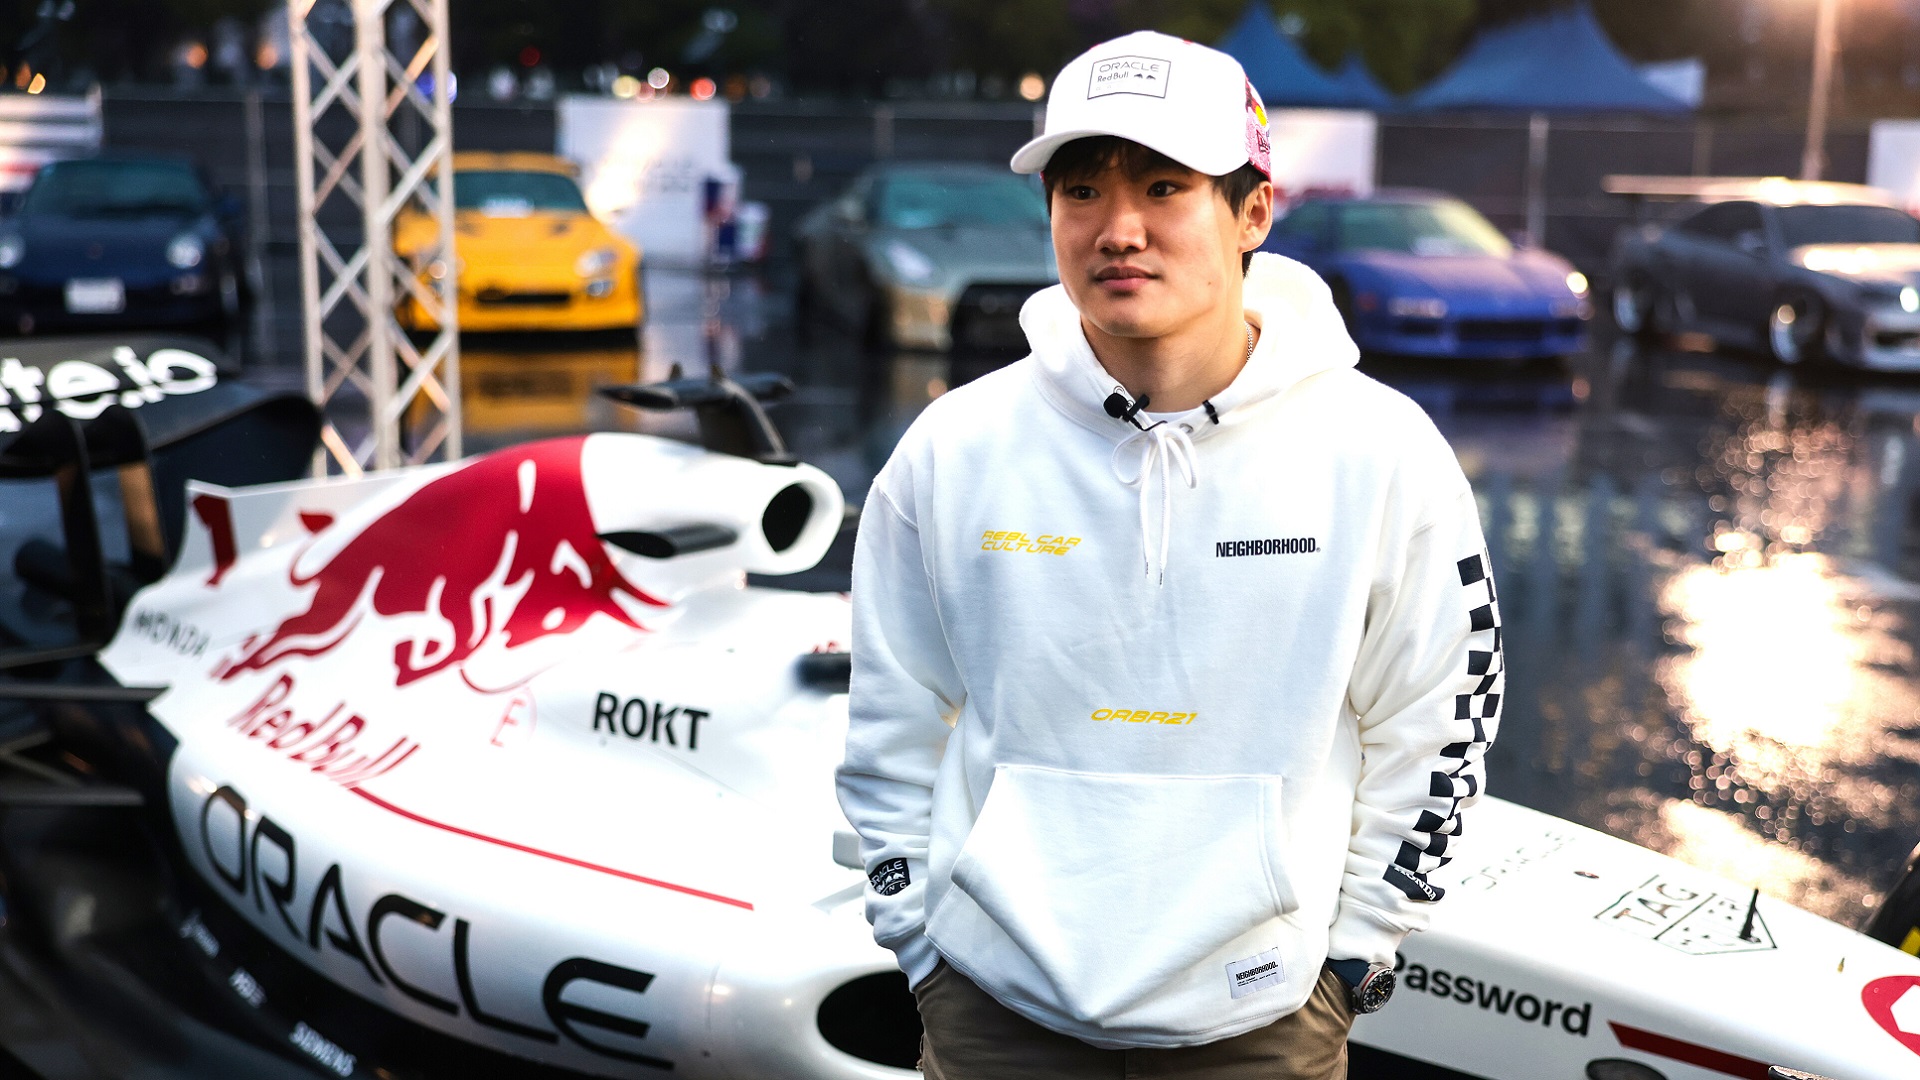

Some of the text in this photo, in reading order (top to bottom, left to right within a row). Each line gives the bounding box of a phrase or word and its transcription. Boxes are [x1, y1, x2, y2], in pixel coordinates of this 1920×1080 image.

[1099, 61, 1160, 73] ORACLE
[981, 530, 1082, 547] REBL CAR
[981, 541, 1070, 556] CULTURE
[593, 692, 710, 750] ROKT
[1091, 708, 1198, 725] ORBR21
[1612, 882, 1699, 927] TAG
[201, 784, 675, 1071] ORACLE
